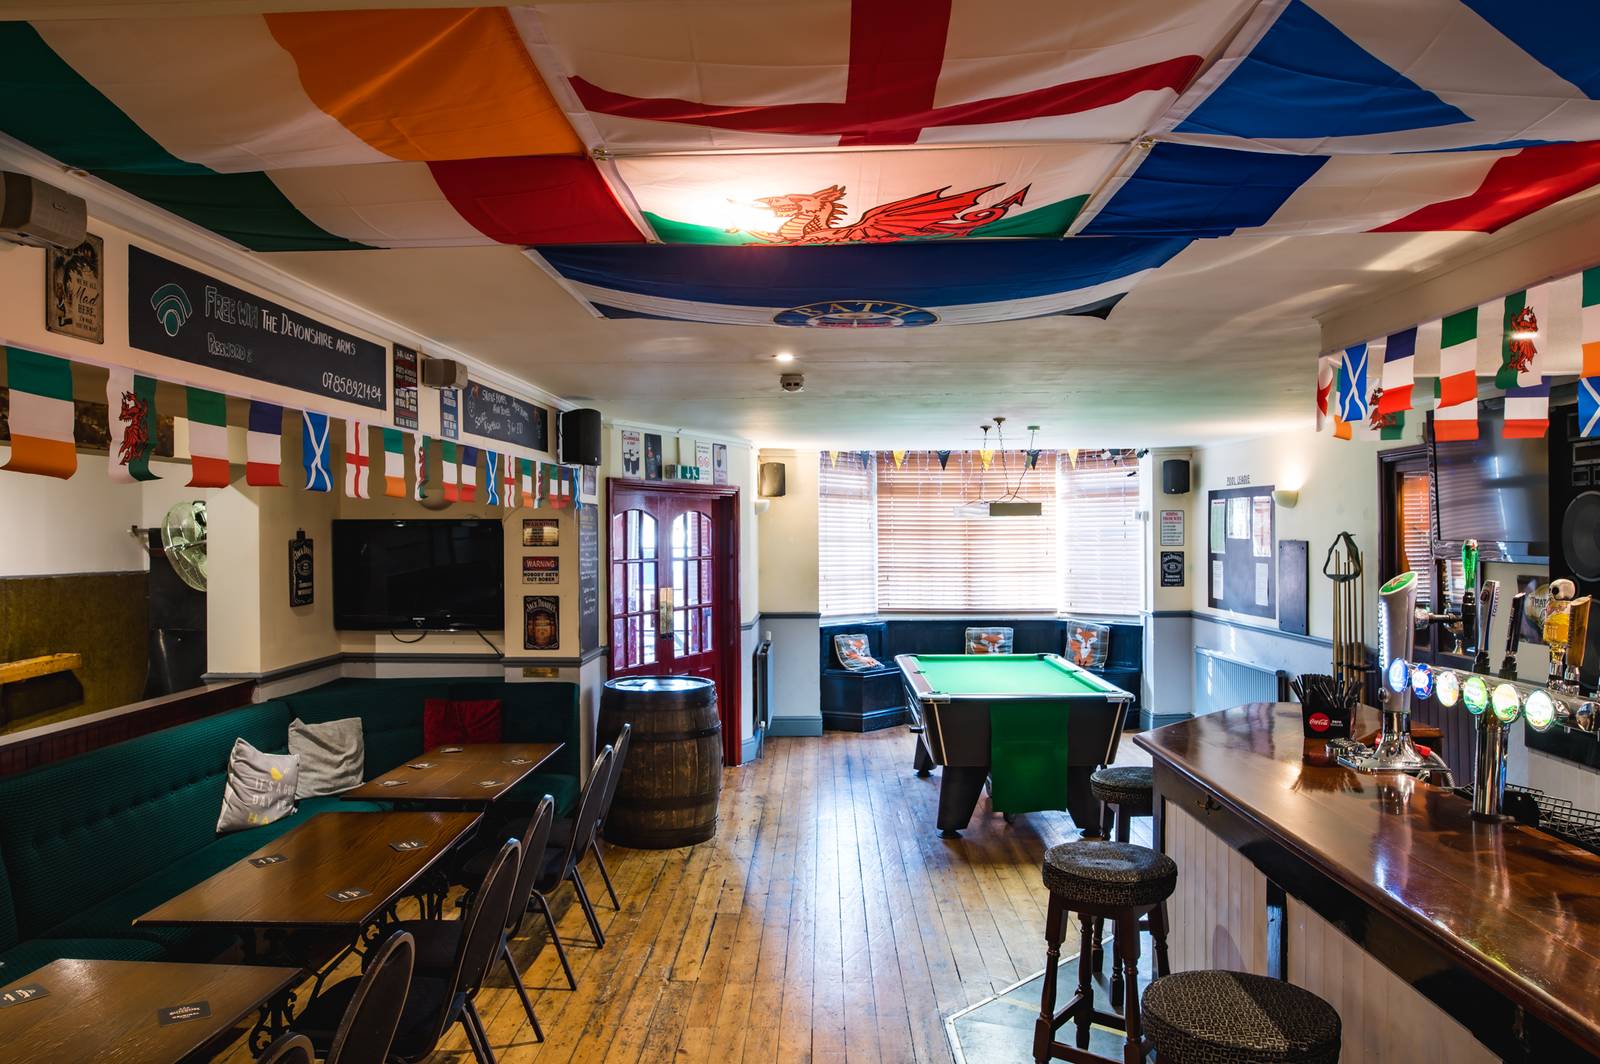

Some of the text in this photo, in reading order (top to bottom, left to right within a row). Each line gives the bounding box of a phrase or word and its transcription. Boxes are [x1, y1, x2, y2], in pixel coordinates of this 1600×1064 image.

[795, 302, 918, 317] BATH
[261, 309, 356, 356] THE DEVONSHIRE ARMS
[322, 371, 382, 402] 07858921484
[526, 560, 556, 568] WARNING
[252, 794, 273, 808] DAY
